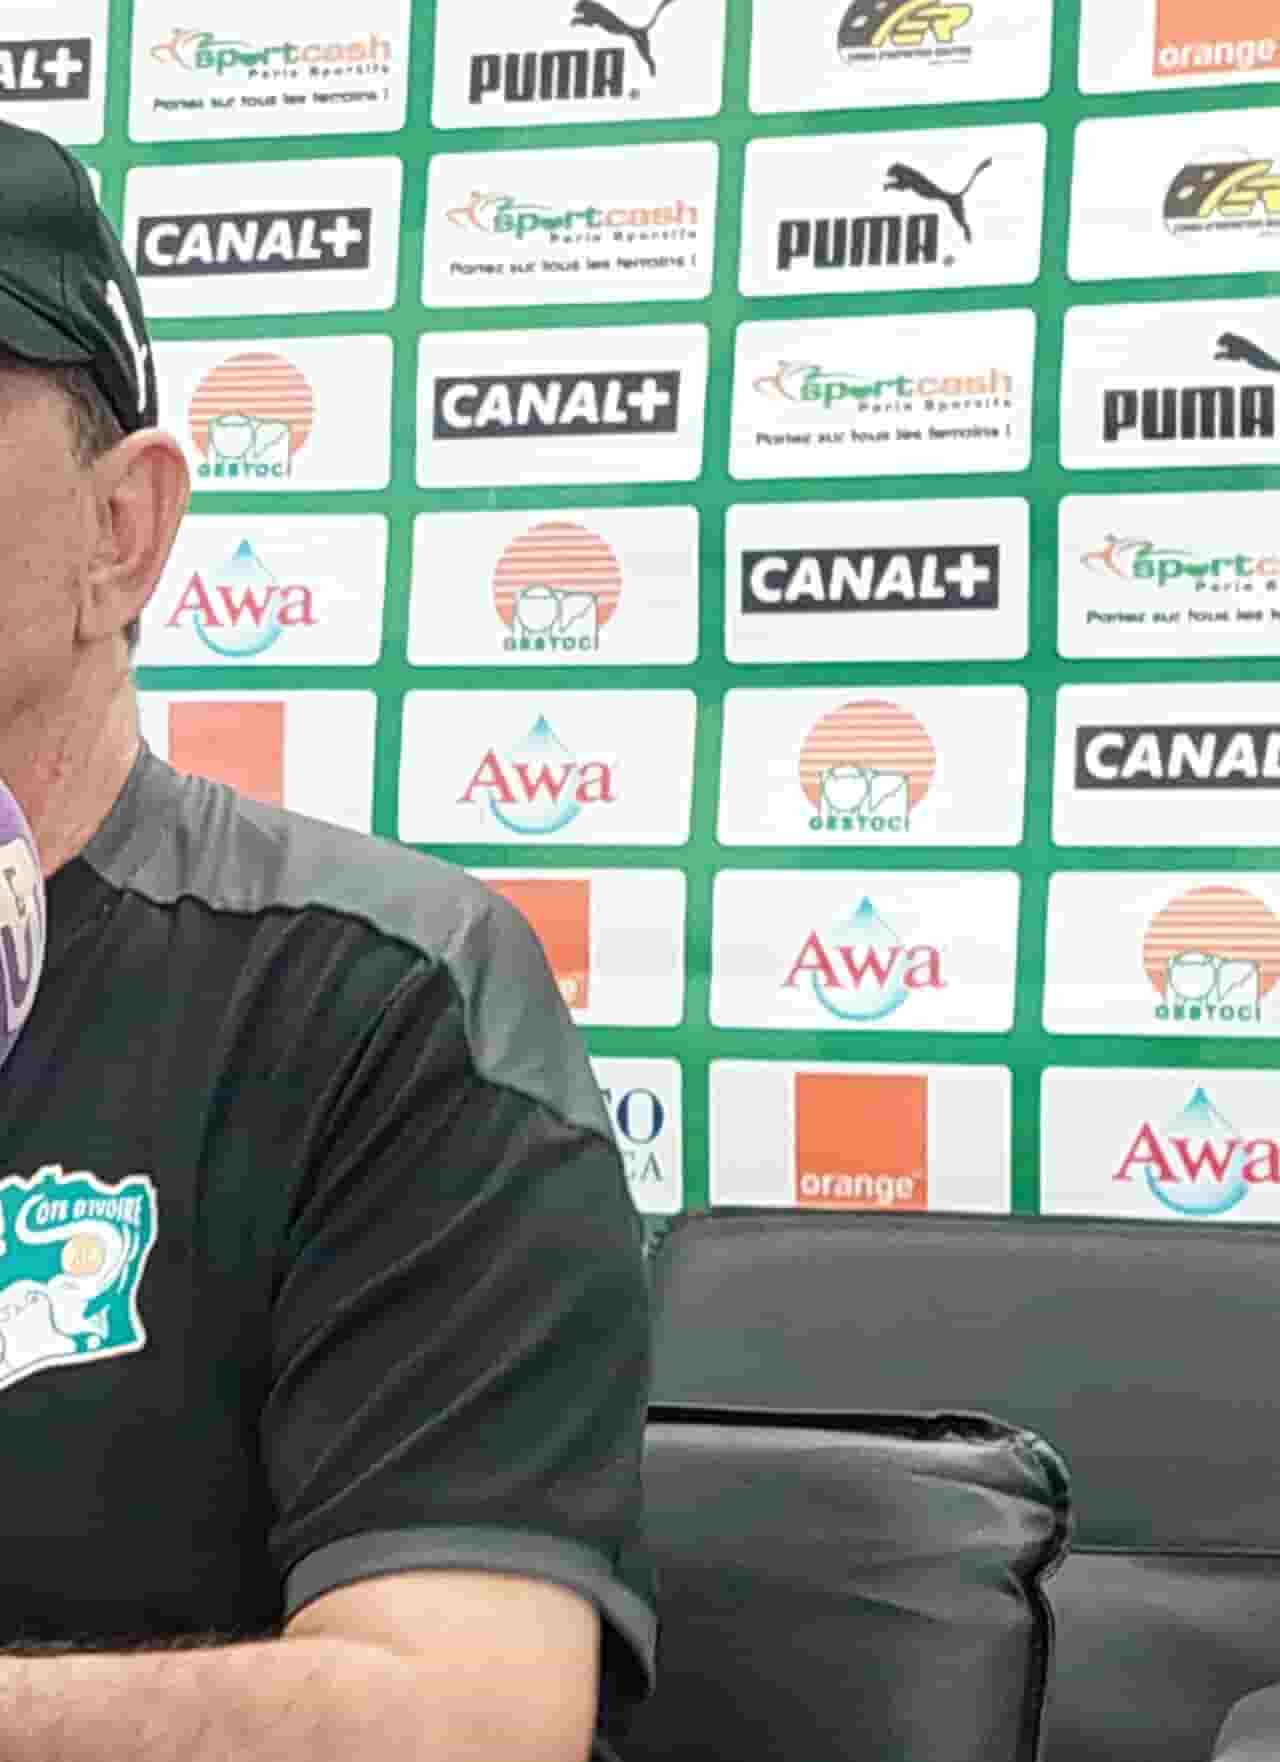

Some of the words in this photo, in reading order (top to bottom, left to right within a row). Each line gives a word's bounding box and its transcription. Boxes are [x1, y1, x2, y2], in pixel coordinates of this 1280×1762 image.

[469, 48, 625, 104] PUMA
[1160, 41, 1272, 69] orange
[144, 216, 362, 266] CANAL+
[776, 214, 940, 270] PUMA
[440, 377, 670, 428] CANAL+
[1104, 385, 1275, 442] PUMA
[164, 571, 318, 628] Awa
[750, 552, 989, 605] CANAL+
[456, 748, 617, 804] Awa
[1084, 733, 1280, 780] CANAL
[808, 814, 910, 832] GESTOCI
[781, 930, 948, 989] Awa
[1111, 1119, 1280, 1184] Awa
[800, 1173, 913, 1205] orange
